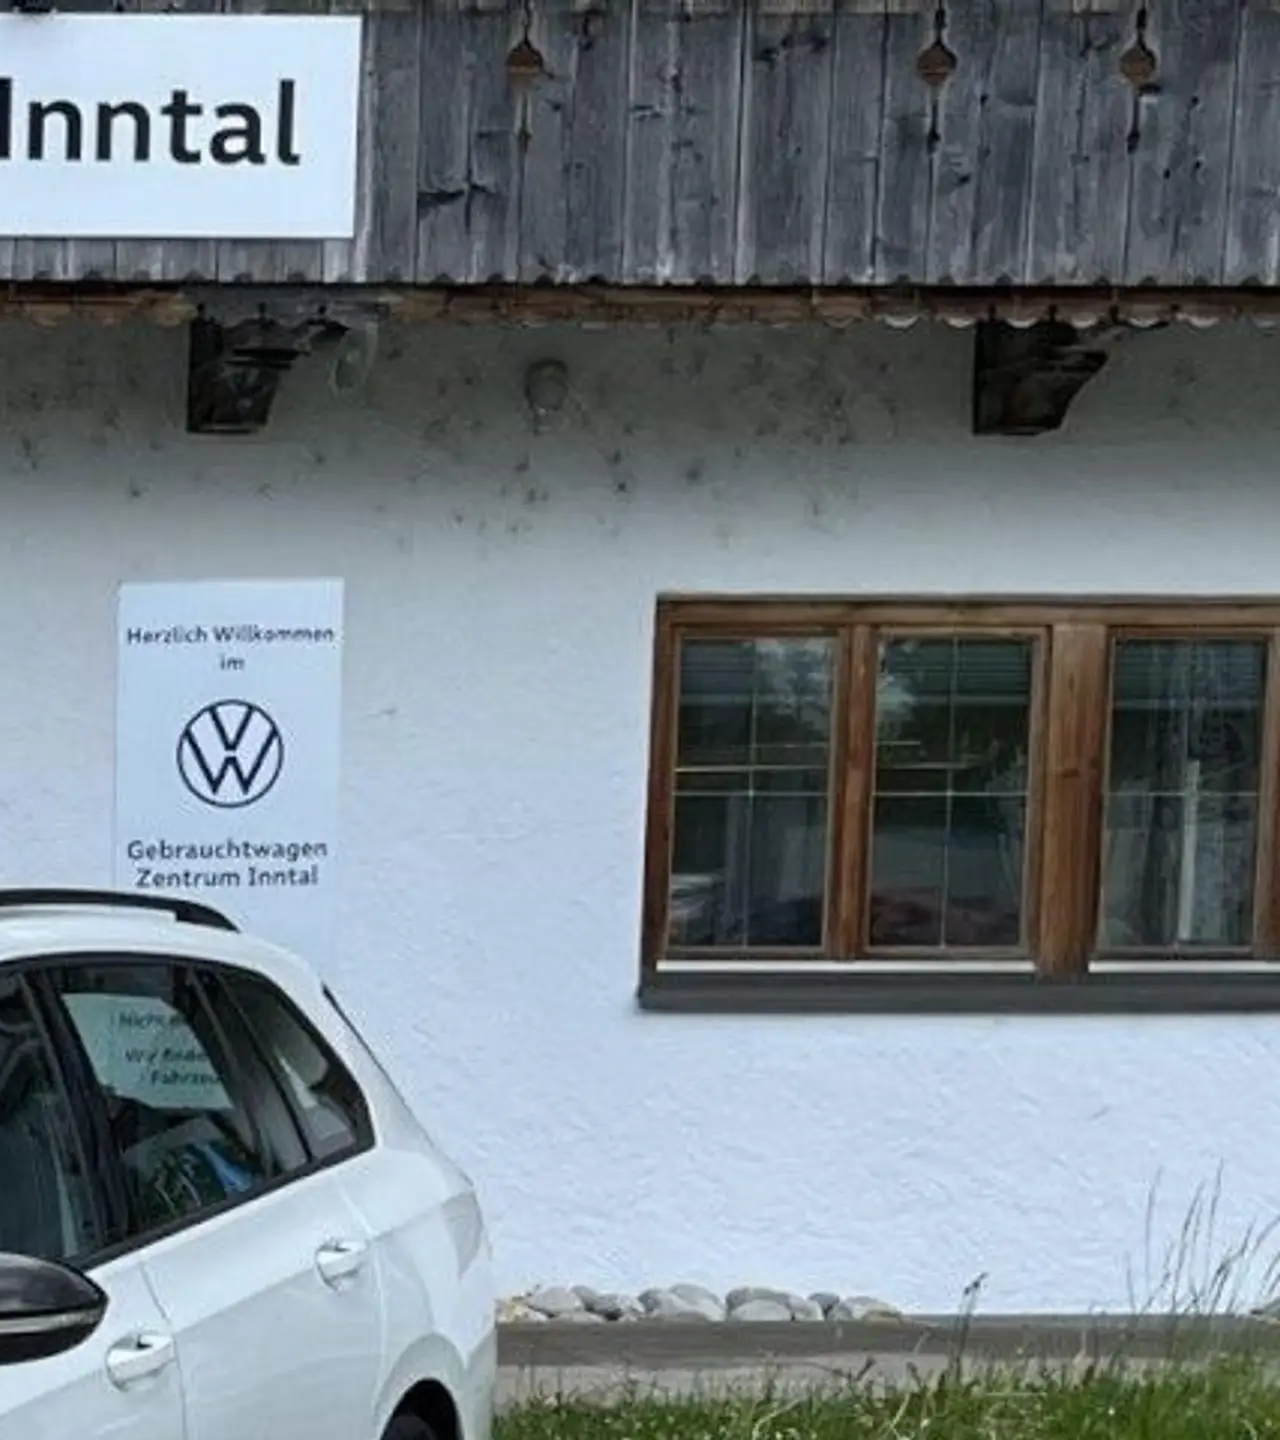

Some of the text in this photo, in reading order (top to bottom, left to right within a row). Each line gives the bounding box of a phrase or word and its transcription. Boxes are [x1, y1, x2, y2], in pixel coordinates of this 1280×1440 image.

[127, 624, 335, 645] Herzlich Willkommen
[219, 654, 246, 671] im
[177, 699, 284, 809] VW
[127, 838, 328, 863] Gebrauchtwagen
[136, 864, 319, 889] Zentrum Inntal
